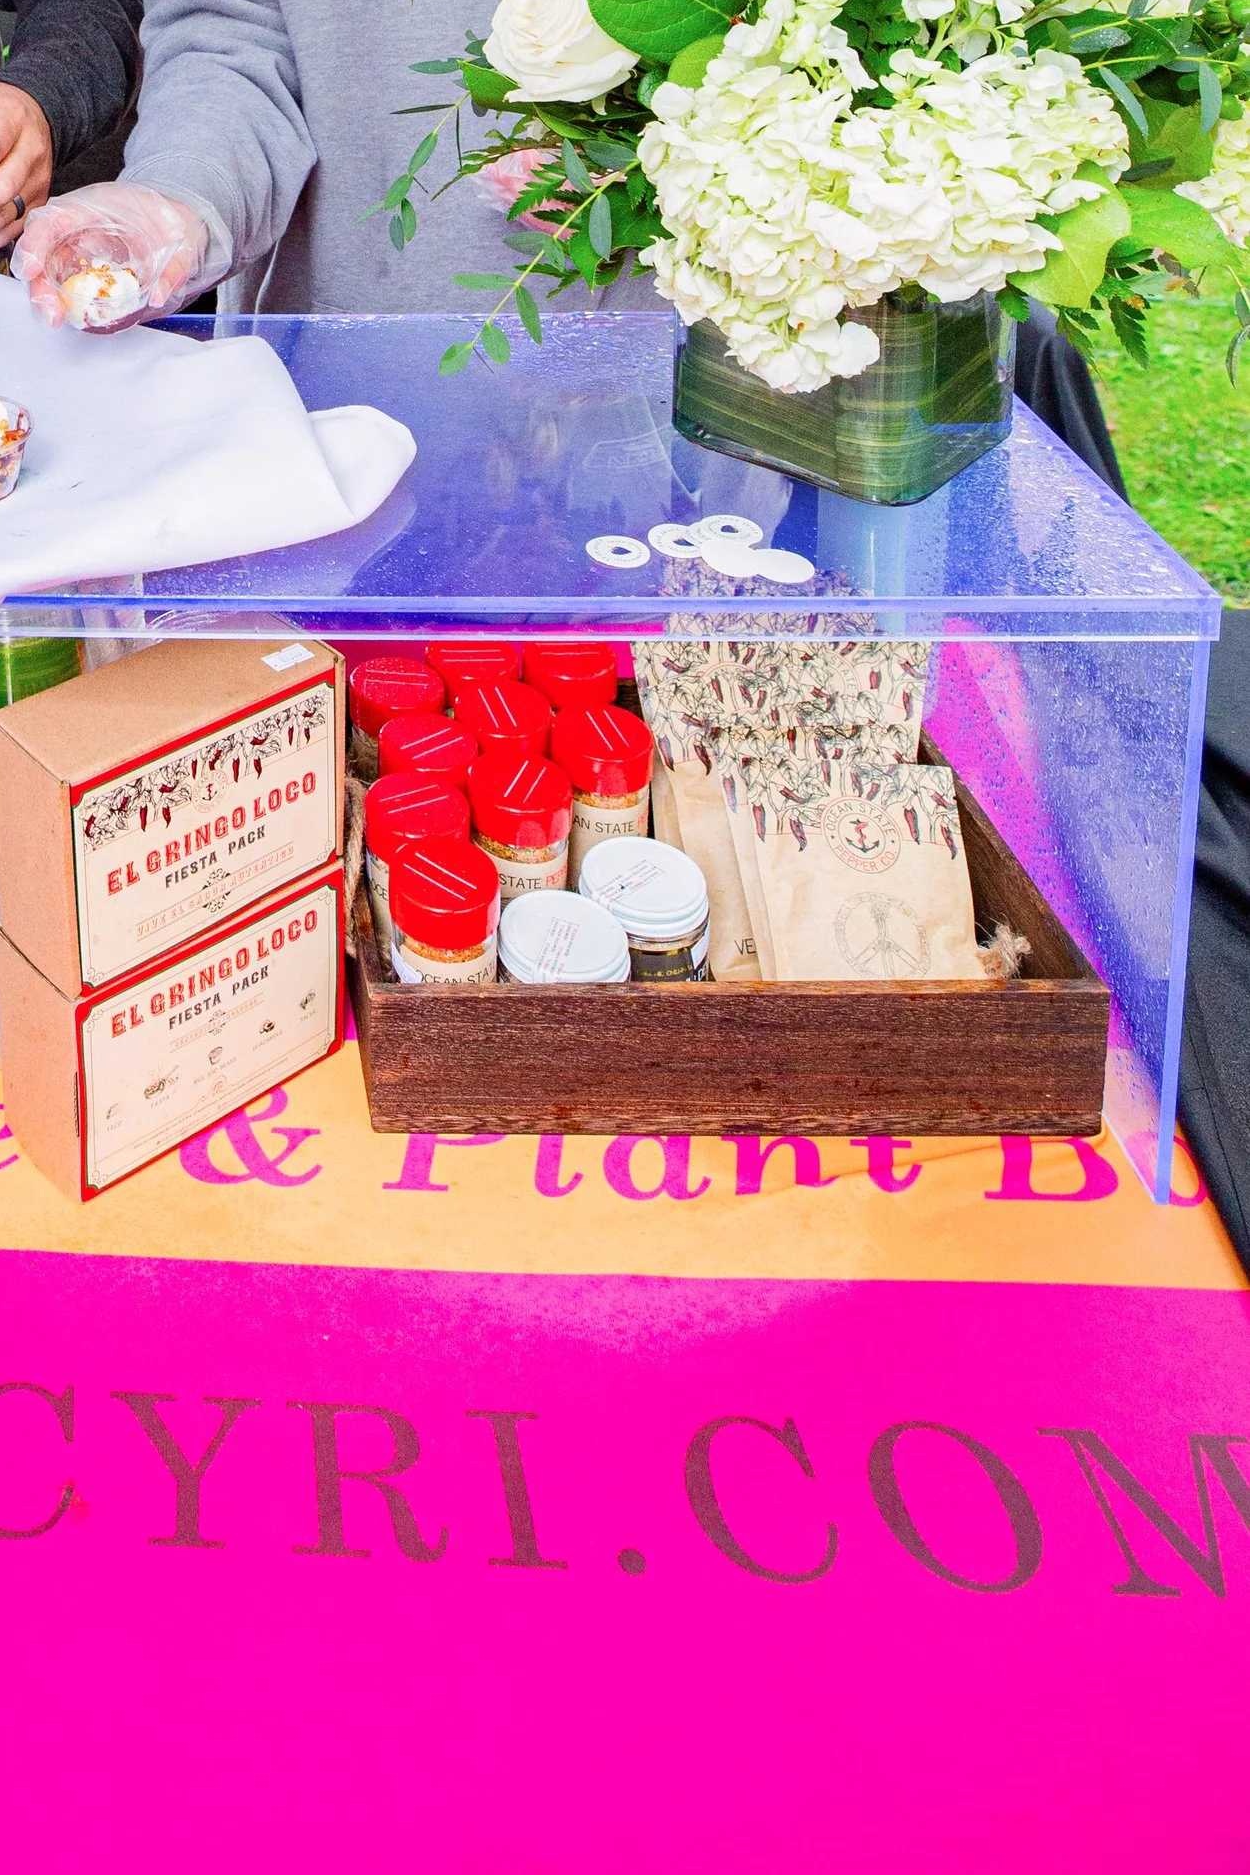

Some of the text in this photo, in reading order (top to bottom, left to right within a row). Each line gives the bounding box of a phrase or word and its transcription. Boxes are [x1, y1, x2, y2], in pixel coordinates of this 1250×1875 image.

[106, 859, 141, 896] EL
[146, 806, 247, 874] GRINGO
[253, 771, 317, 821] LOCO
[595, 821, 634, 834] STATE
[825, 802, 896, 837] OCEAN STATE
[165, 825, 266, 889] FIESTA PACK
[499, 873, 542, 889] STATE
[834, 844, 898, 872] PEPPER CO.
[111, 1003, 144, 1038] EL
[150, 948, 250, 1017] GRINGO
[257, 909, 318, 962] LOCO
[168, 993, 221, 1030] FIESTA
[231, 965, 269, 996] PACK
